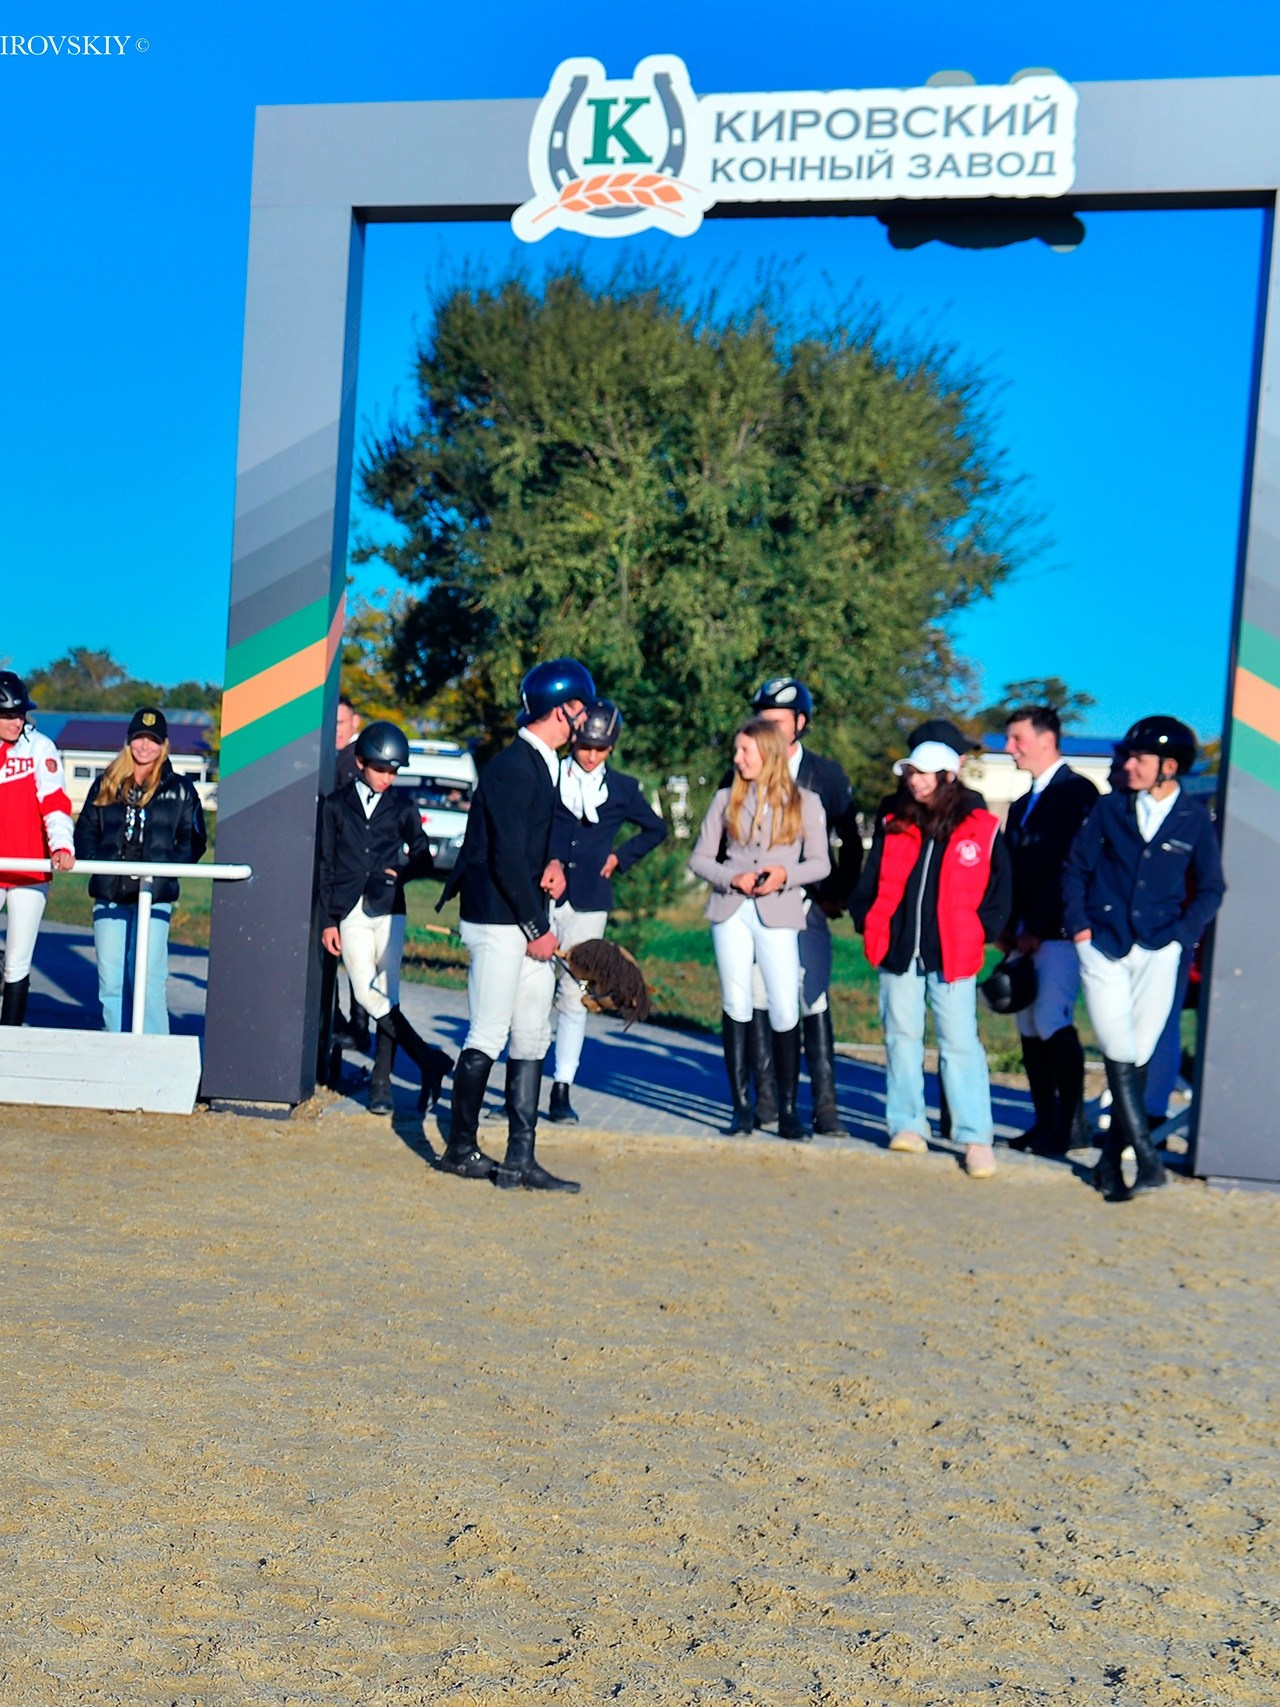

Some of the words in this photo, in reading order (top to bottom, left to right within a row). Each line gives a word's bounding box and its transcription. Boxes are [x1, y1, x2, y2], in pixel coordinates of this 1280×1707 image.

[714, 94, 1059, 145] КИРОВСКИЙ
[710, 149, 894, 183] КОННЫЙ
[907, 151, 1057, 180] ЗАВОД
